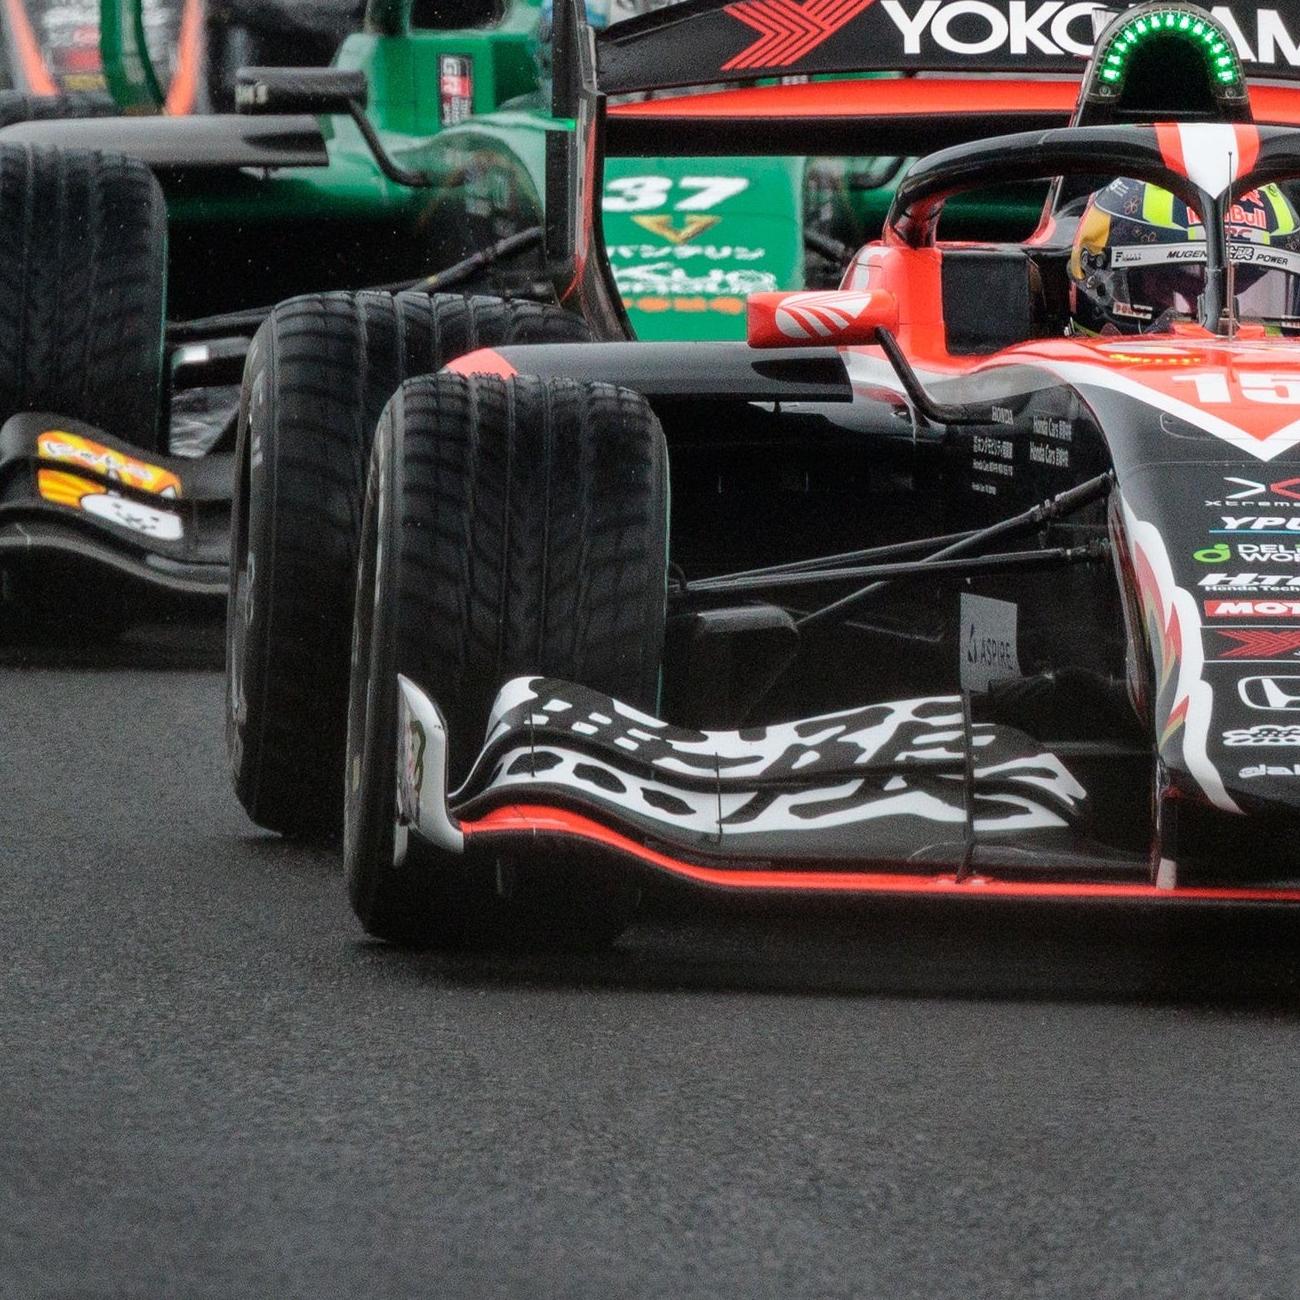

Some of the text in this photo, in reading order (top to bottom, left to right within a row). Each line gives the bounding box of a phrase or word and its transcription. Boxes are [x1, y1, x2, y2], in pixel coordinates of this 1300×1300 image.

[602, 176, 749, 212] 37
[1166, 250, 1207, 260] MUGEN
[1256, 253, 1288, 266] POWER
[1204, 585, 1258, 593] Honda
[981, 637, 1013, 670] ASPIRE
